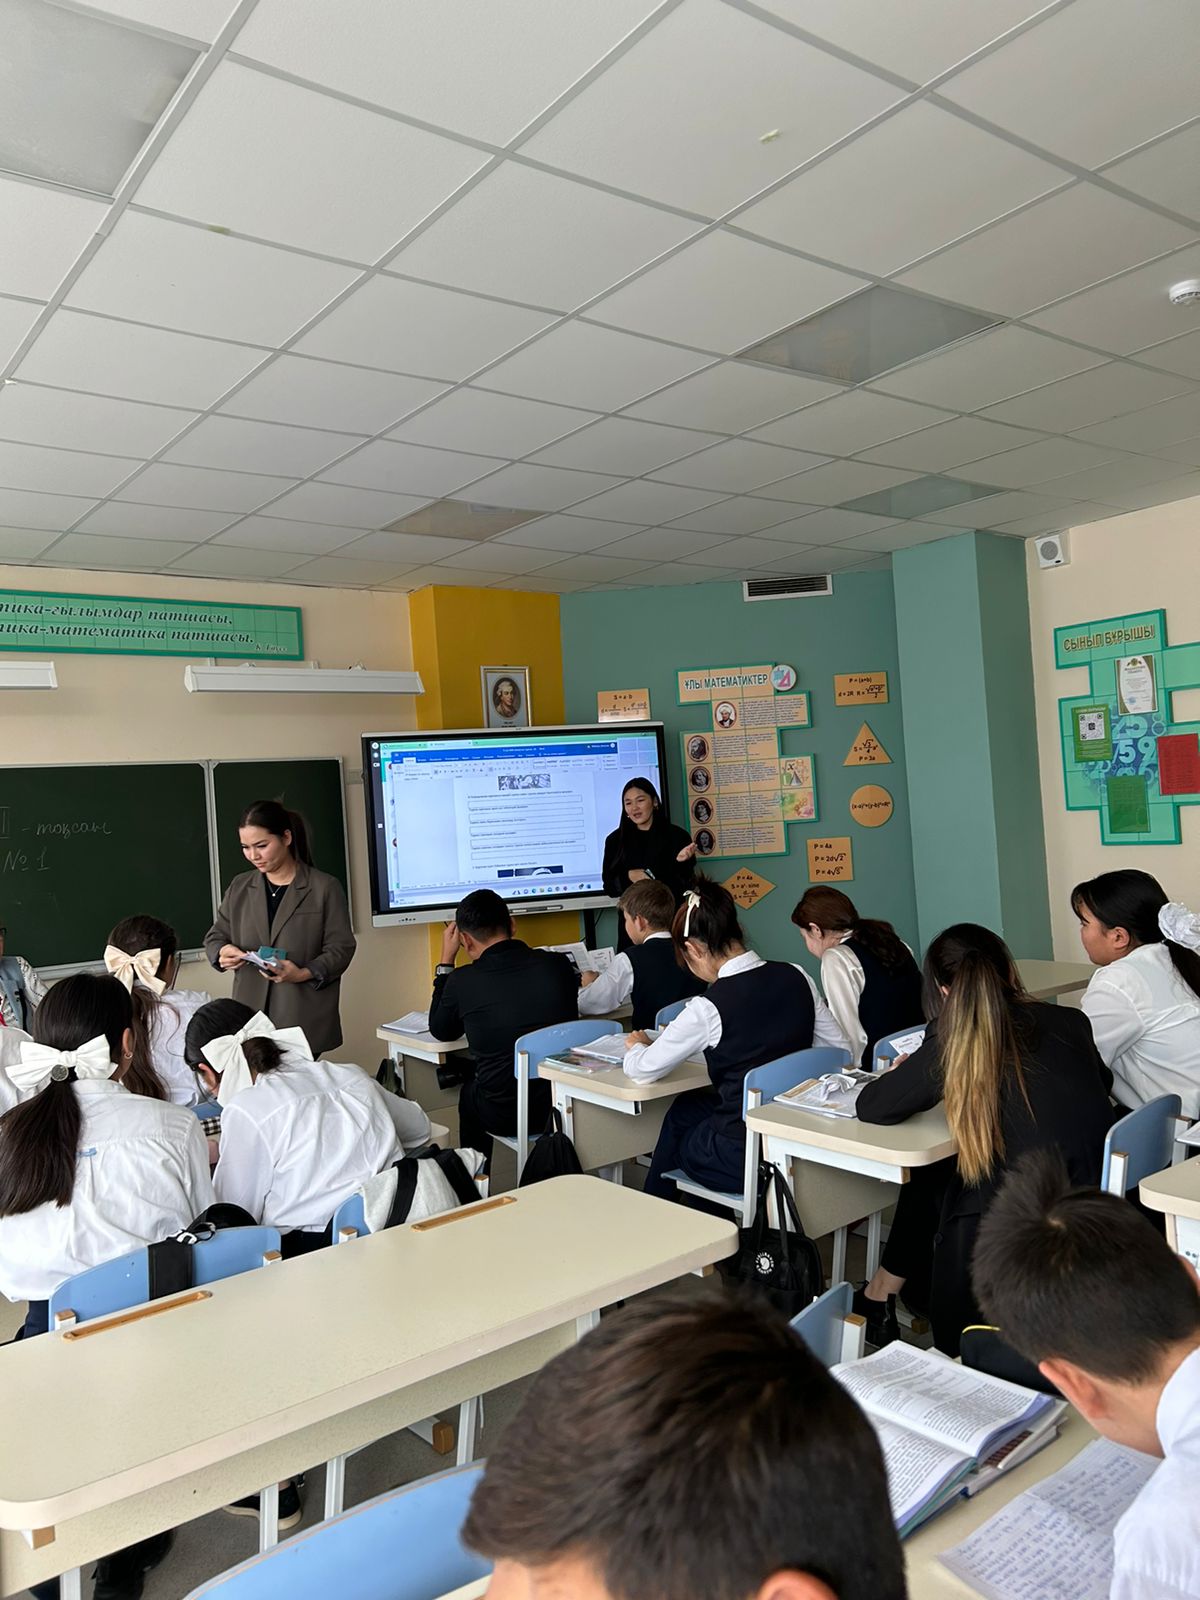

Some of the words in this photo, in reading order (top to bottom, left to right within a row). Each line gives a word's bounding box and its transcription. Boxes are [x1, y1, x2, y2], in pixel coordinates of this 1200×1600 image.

[171, 630, 254, 643] патшасы.
[1063, 633, 1103, 652] СЫНЫП
[1104, 624, 1155, 645] БҰРЫШЫ
[704, 673, 768, 688] МАТЕМАТИКТЕР
